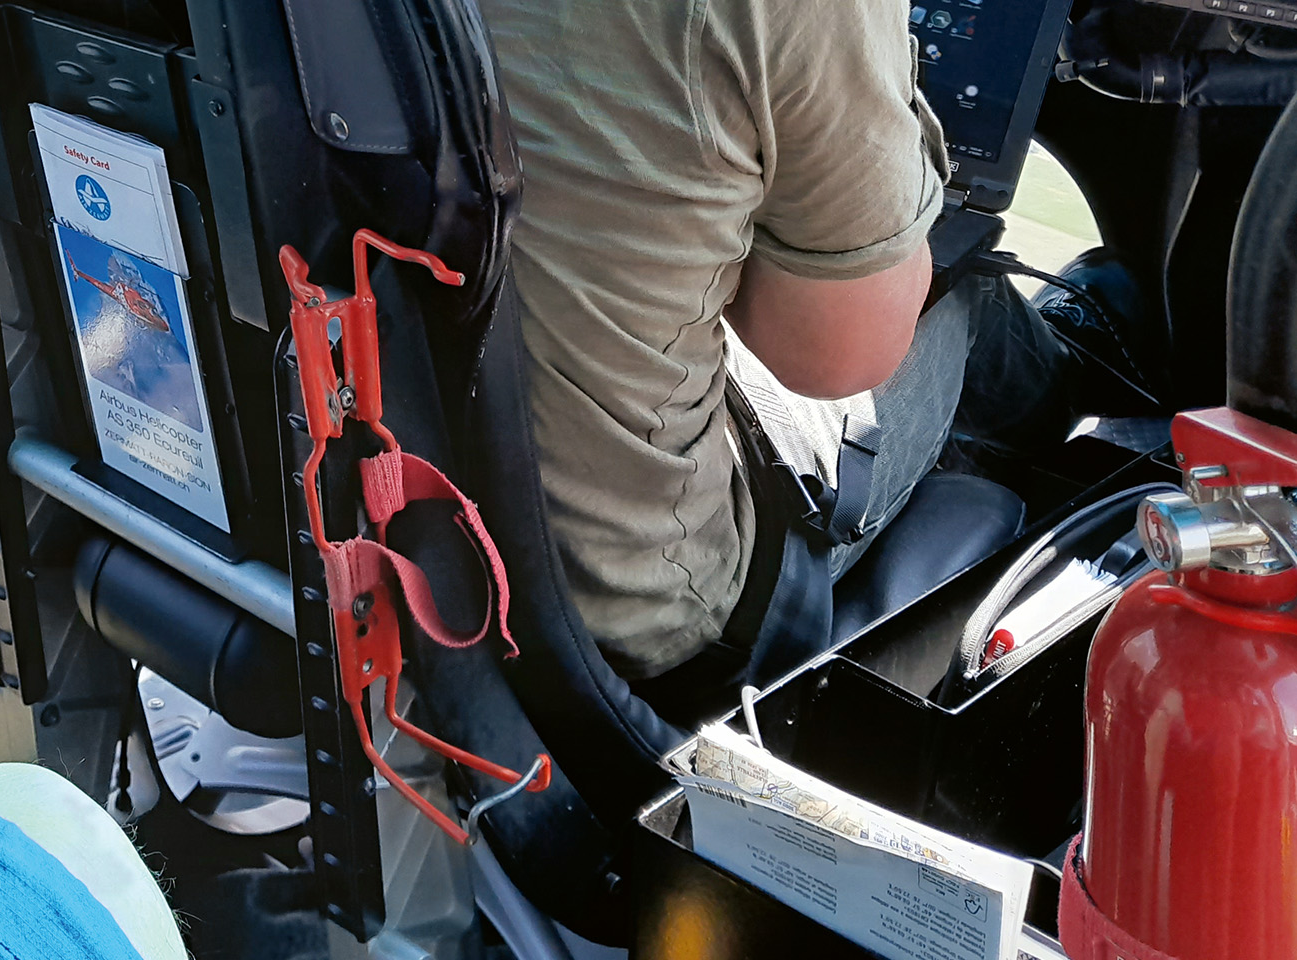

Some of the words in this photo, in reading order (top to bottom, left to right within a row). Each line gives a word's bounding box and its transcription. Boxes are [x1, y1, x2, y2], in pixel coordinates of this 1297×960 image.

[1212, 0, 1221, 8] P1
[1238, 4, 1248, 12] P2
[1266, 9, 1276, 17] P3
[64, 145, 89, 164] Safety
[90, 156, 110, 171] Card
[100, 389, 137, 416] Airbus
[139, 409, 203, 452] Helicopter
[107, 409, 124, 427] AS
[126, 419, 150, 441] 350
[153, 433, 204, 469] Ecureuil
